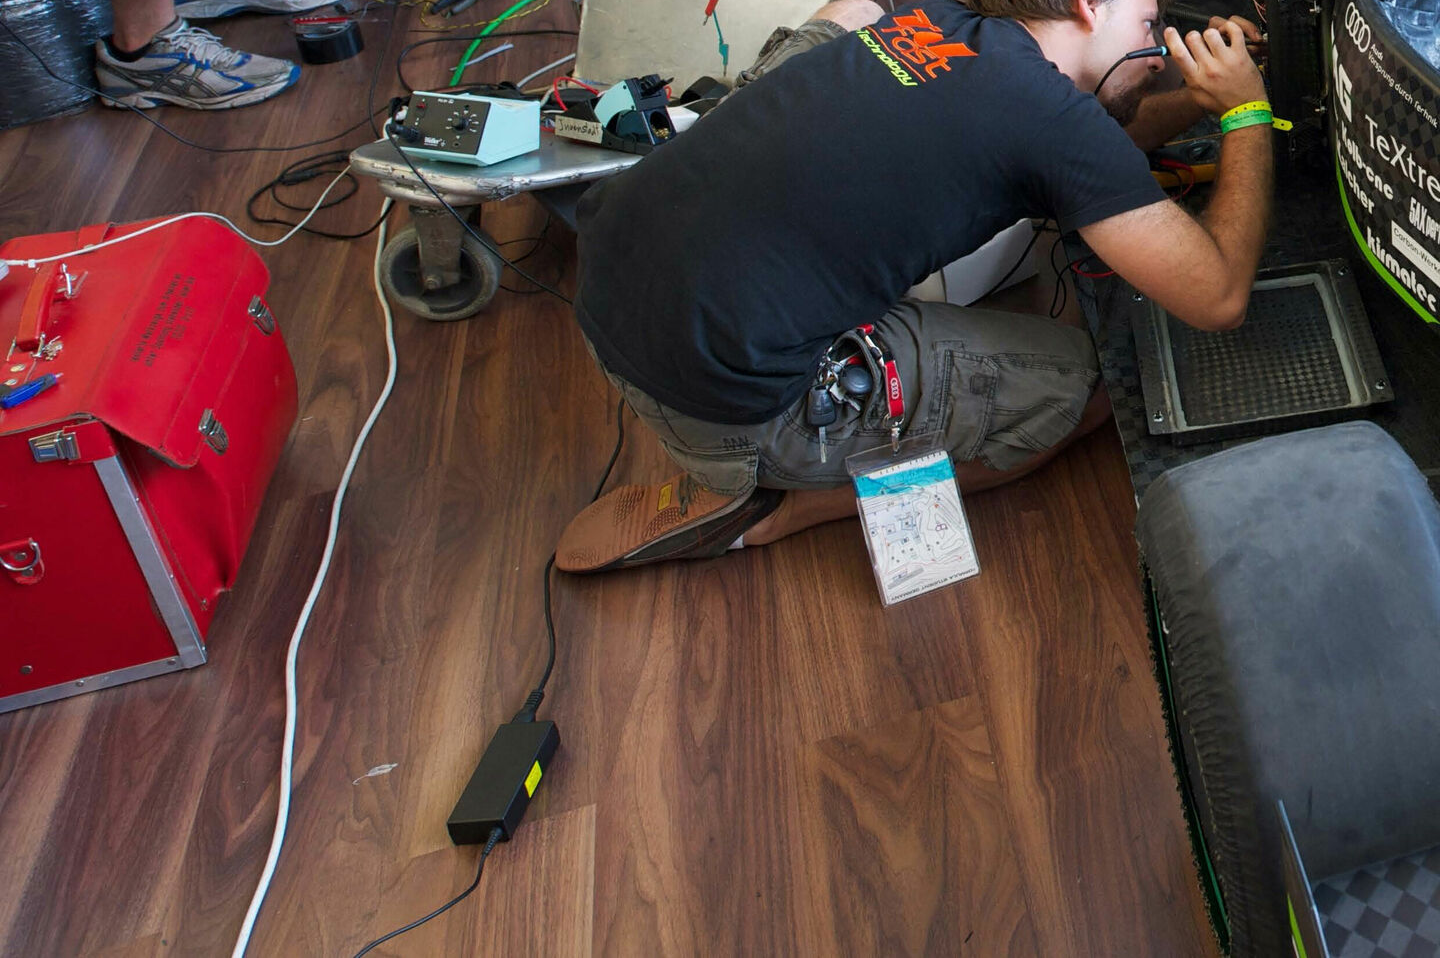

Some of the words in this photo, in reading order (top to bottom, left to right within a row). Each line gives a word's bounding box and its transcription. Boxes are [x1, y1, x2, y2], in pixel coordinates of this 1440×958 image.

[881, 26, 952, 79] fast
[893, 8, 979, 58] TU
[1370, 43, 1384, 61] Audi
[1368, 52, 1396, 88] Vorsprung
[1394, 83, 1413, 105] durch
[1414, 101, 1438, 128] Technik
[1367, 226, 1437, 313] kirmatec
